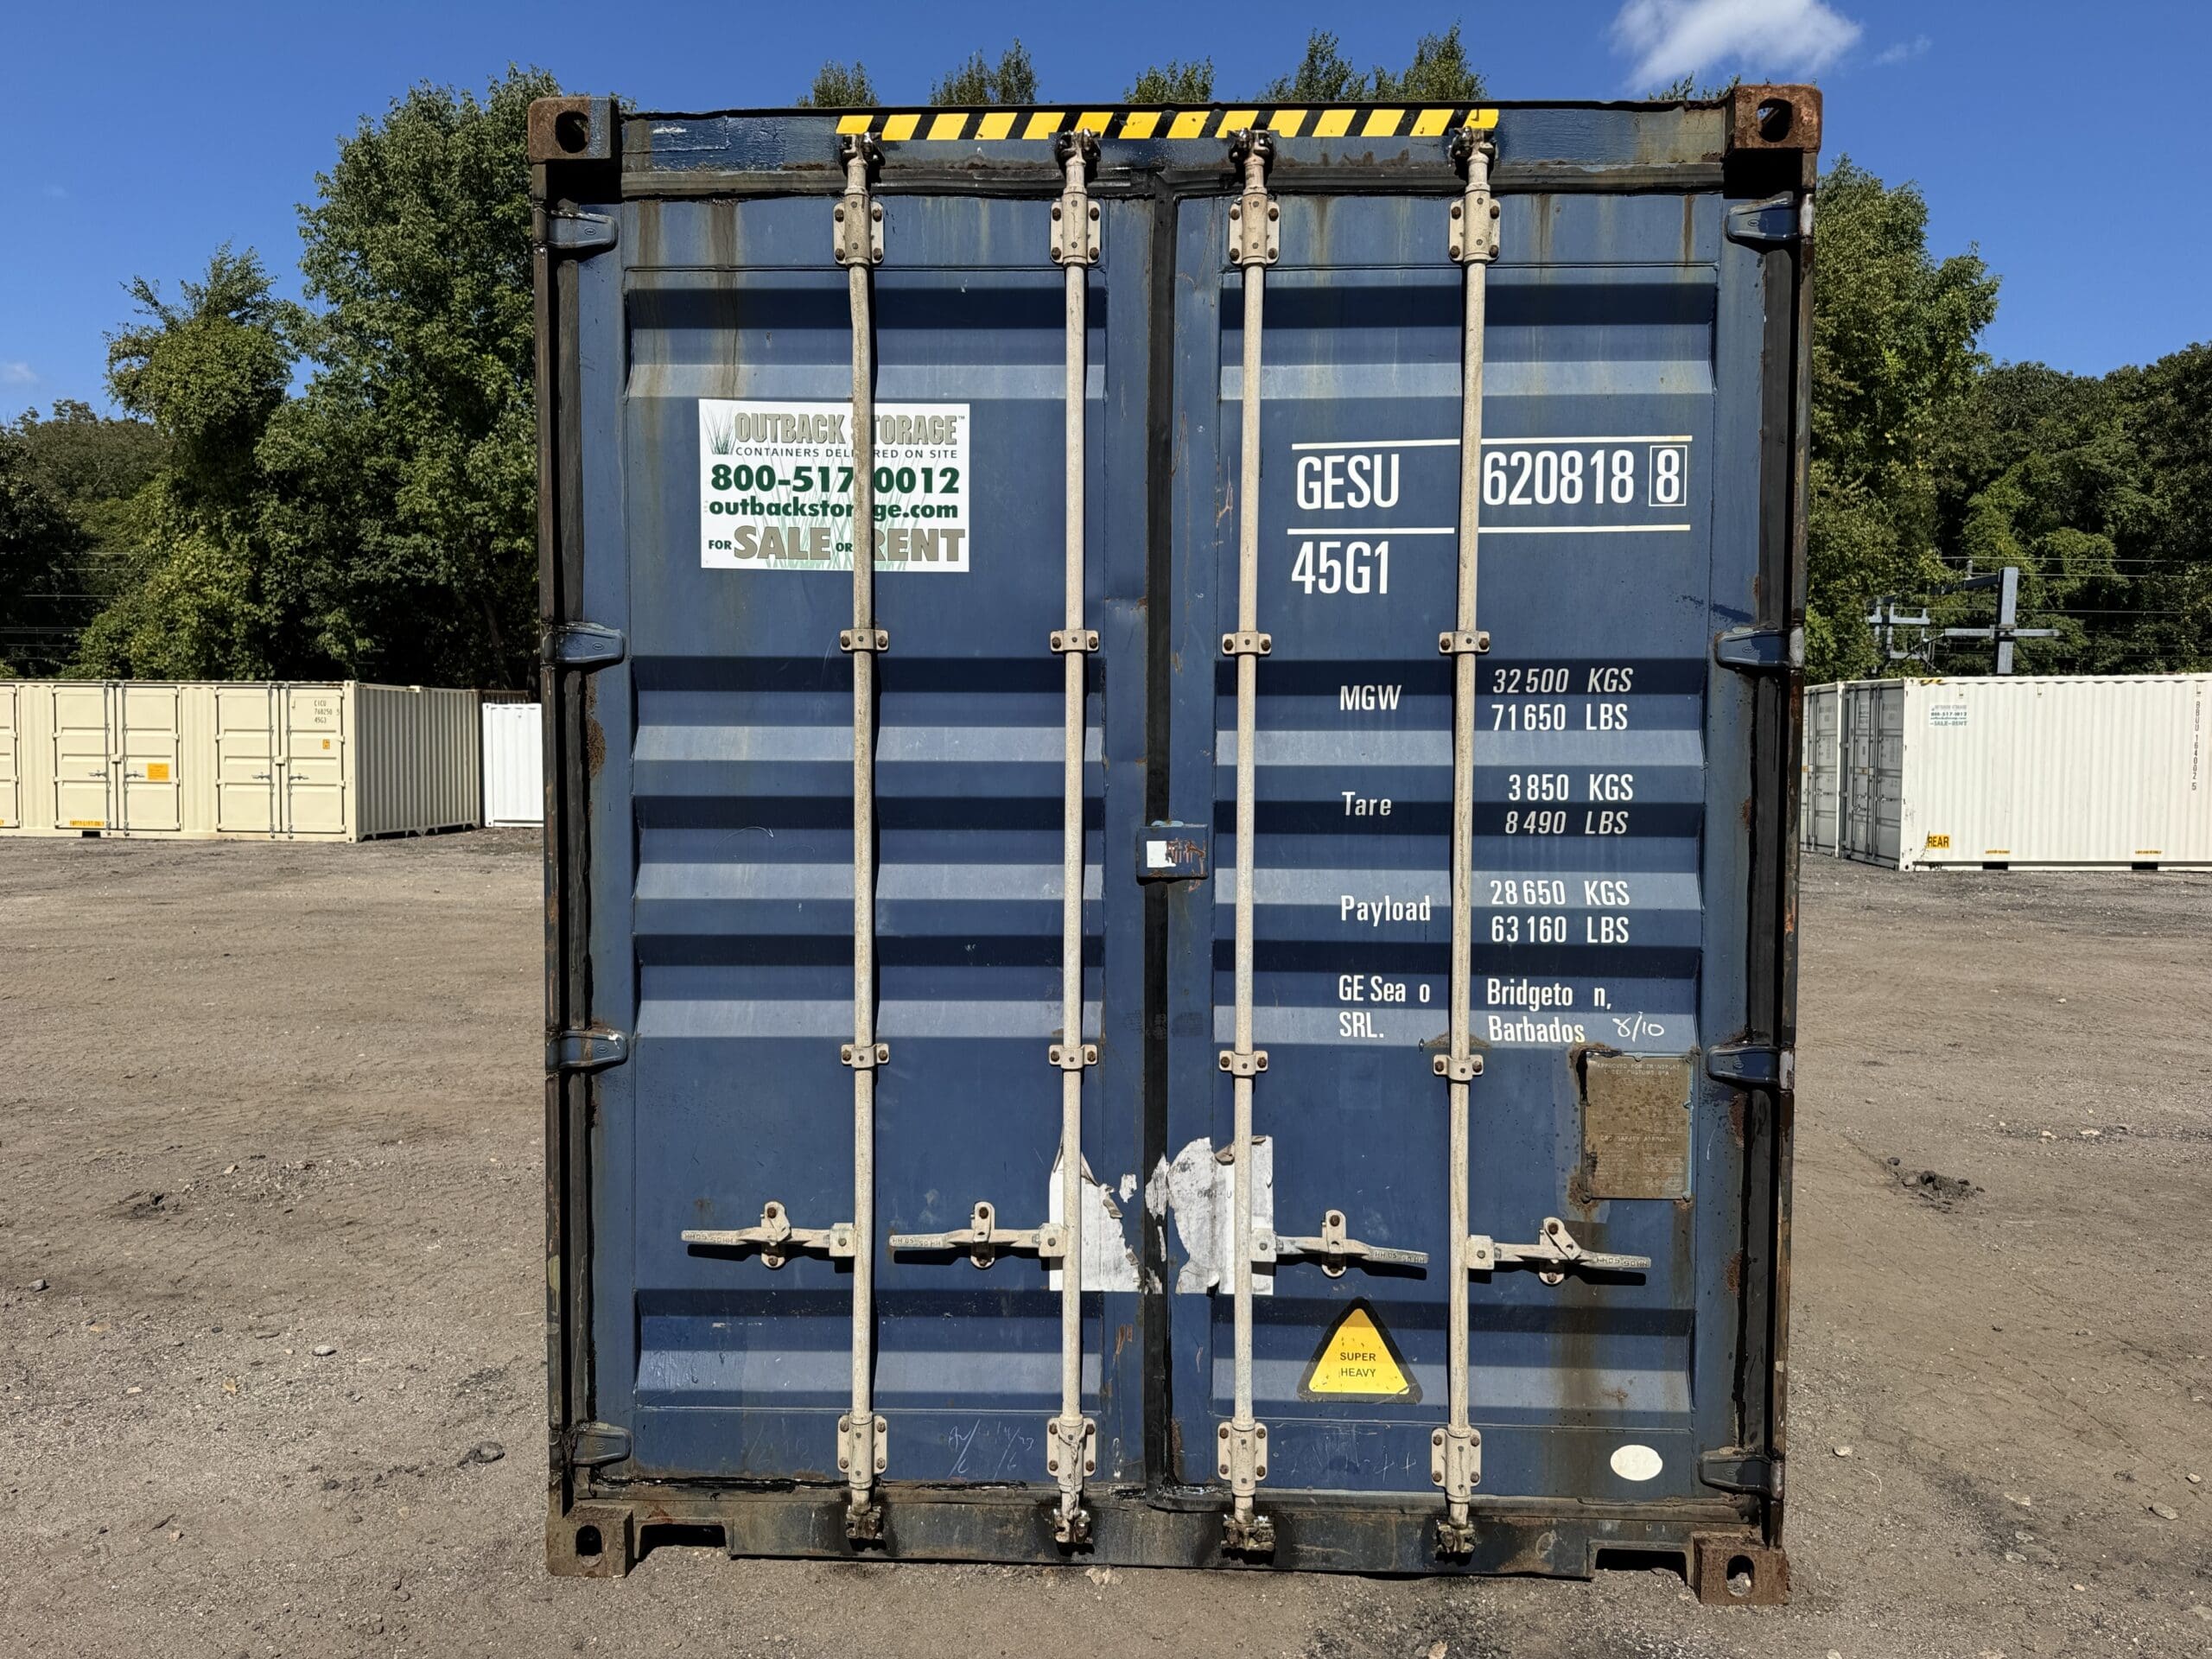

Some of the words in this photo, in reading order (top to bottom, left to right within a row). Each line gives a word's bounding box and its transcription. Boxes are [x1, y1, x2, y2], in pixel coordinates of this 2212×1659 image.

[734, 413, 846, 444] OUTBACK
[851, 415, 957, 445] TORAGE
[736, 448, 819, 458] CONTAINERS
[826, 448, 899, 459] DELIRED
[905, 449, 923, 459] ON
[931, 449, 957, 459] SITE
[711, 464, 960, 493] 800-5170012
[1297, 454, 1399, 510] GESU
[1483, 449, 1634, 505] 620818
[1656, 449, 1680, 503] 8
[709, 497, 958, 522] outbackstorge.com
[709, 539, 732, 550] FOR
[734, 525, 830, 560] SALE
[836, 543, 853, 552] OR
[1292, 541, 1389, 594] 45G1
[1588, 668, 1633, 693] KGS
[1340, 685, 1402, 711] MGW
[1586, 703, 1628, 731] LBS
[1590, 774, 1633, 801] KGS
[1342, 791, 1391, 816] Tare
[1585, 810, 1629, 835] LBS
[1928, 836, 1949, 848] REAR
[1585, 880, 1630, 906] KGS
[1341, 895, 1431, 927] Payload
[1587, 917, 1629, 944] LBS
[1339, 975, 1364, 1001] GE
[1339, 1012, 1384, 1039] SRL.
[1488, 1015, 1586, 1043] Barbados
[1340, 1351, 1376, 1362] SUPER
[1340, 1367, 1376, 1377] HEAVY
